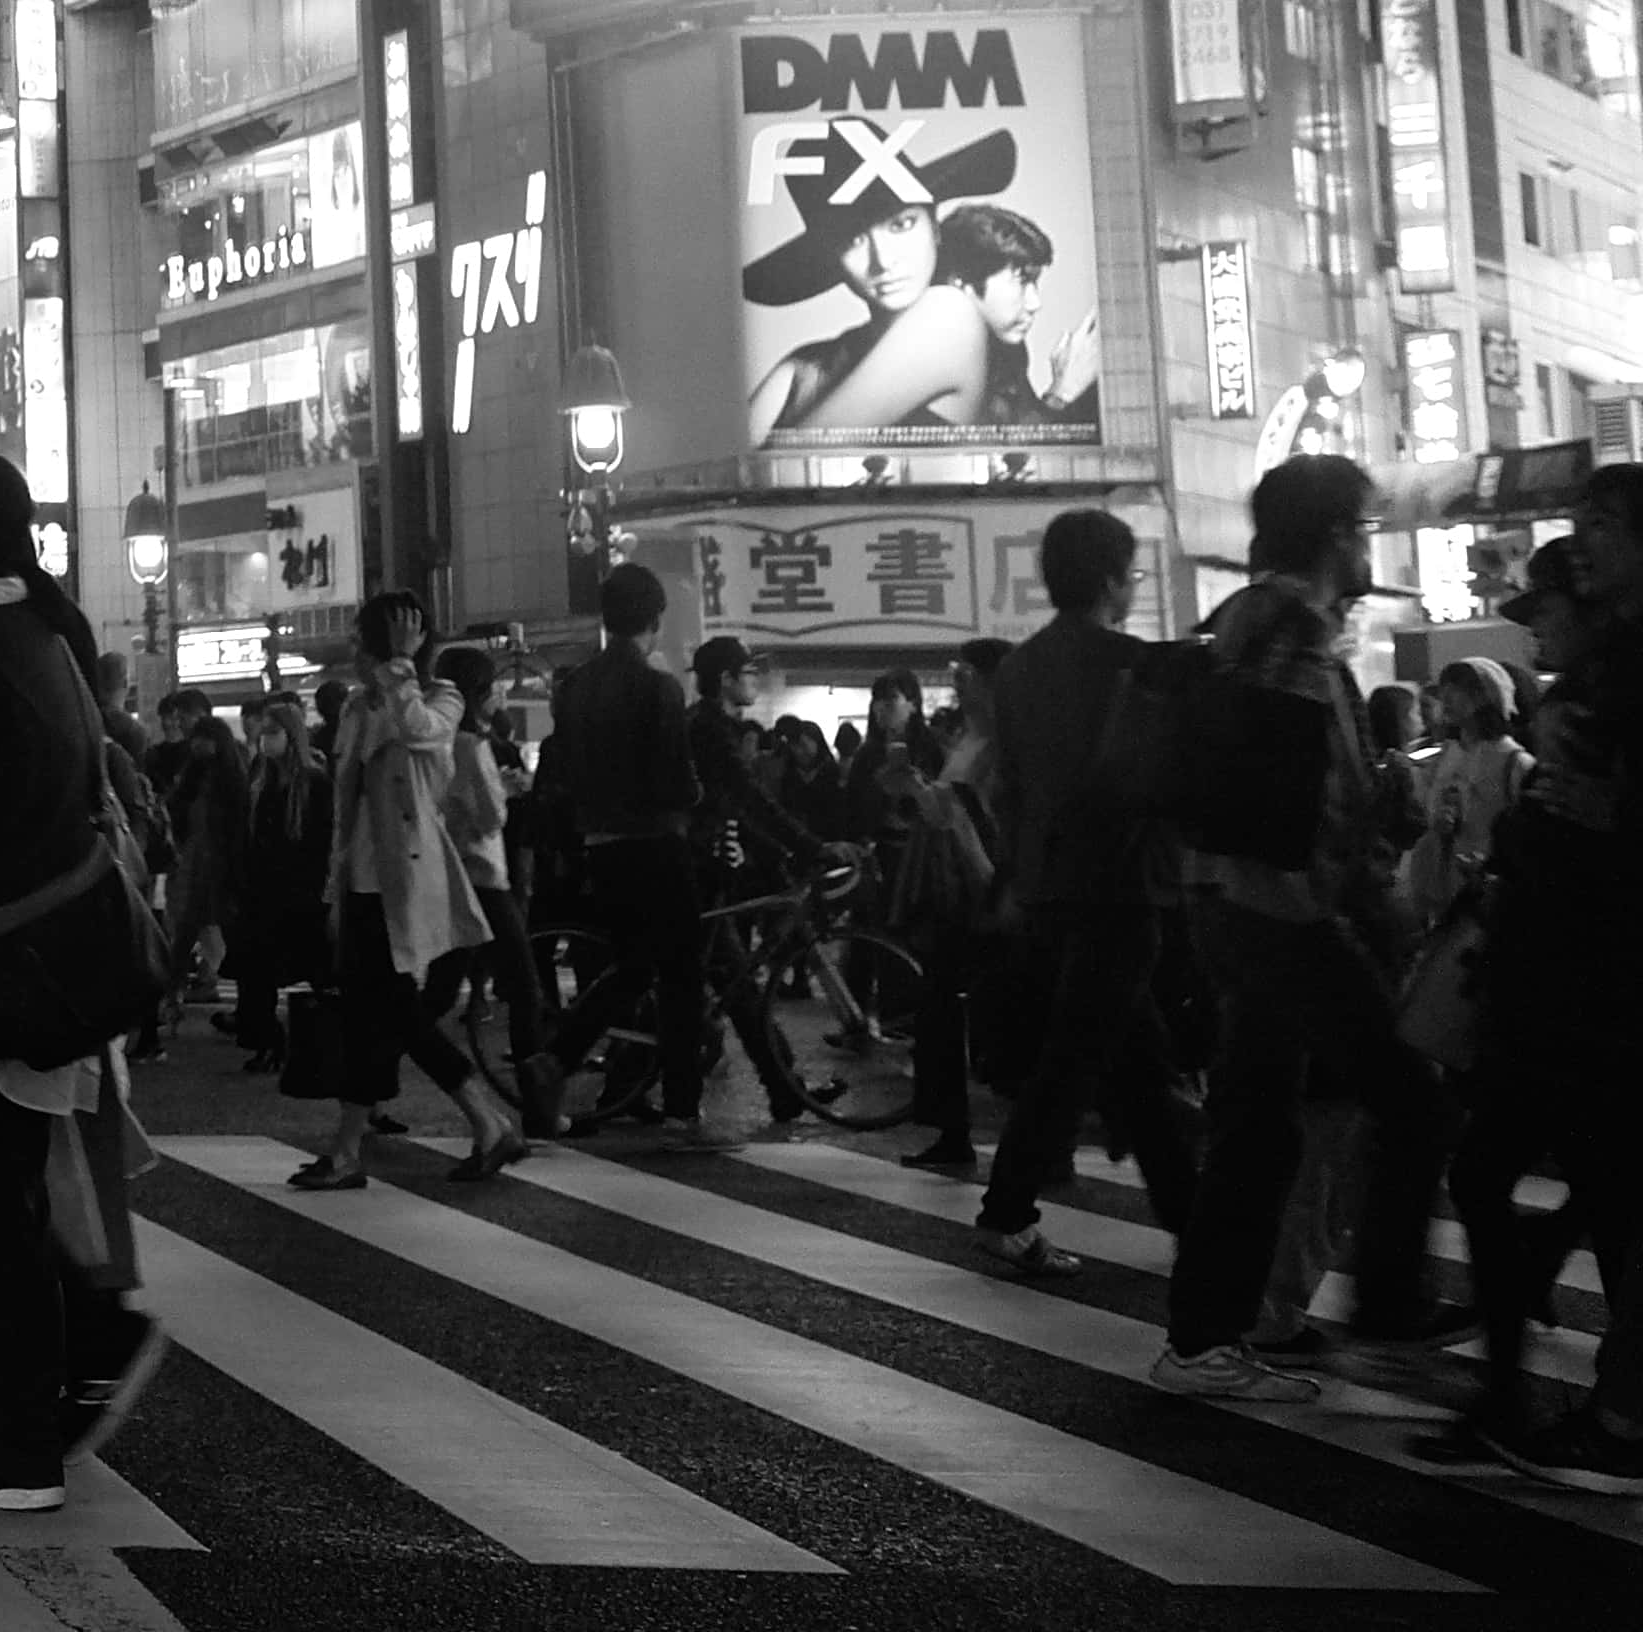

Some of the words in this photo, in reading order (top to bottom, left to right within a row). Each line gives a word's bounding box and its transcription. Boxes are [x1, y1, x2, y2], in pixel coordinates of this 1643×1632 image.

[741, 28, 1025, 114] DMM
[746, 119, 934, 206] FX
[166, 225, 307, 306] Euphoria
